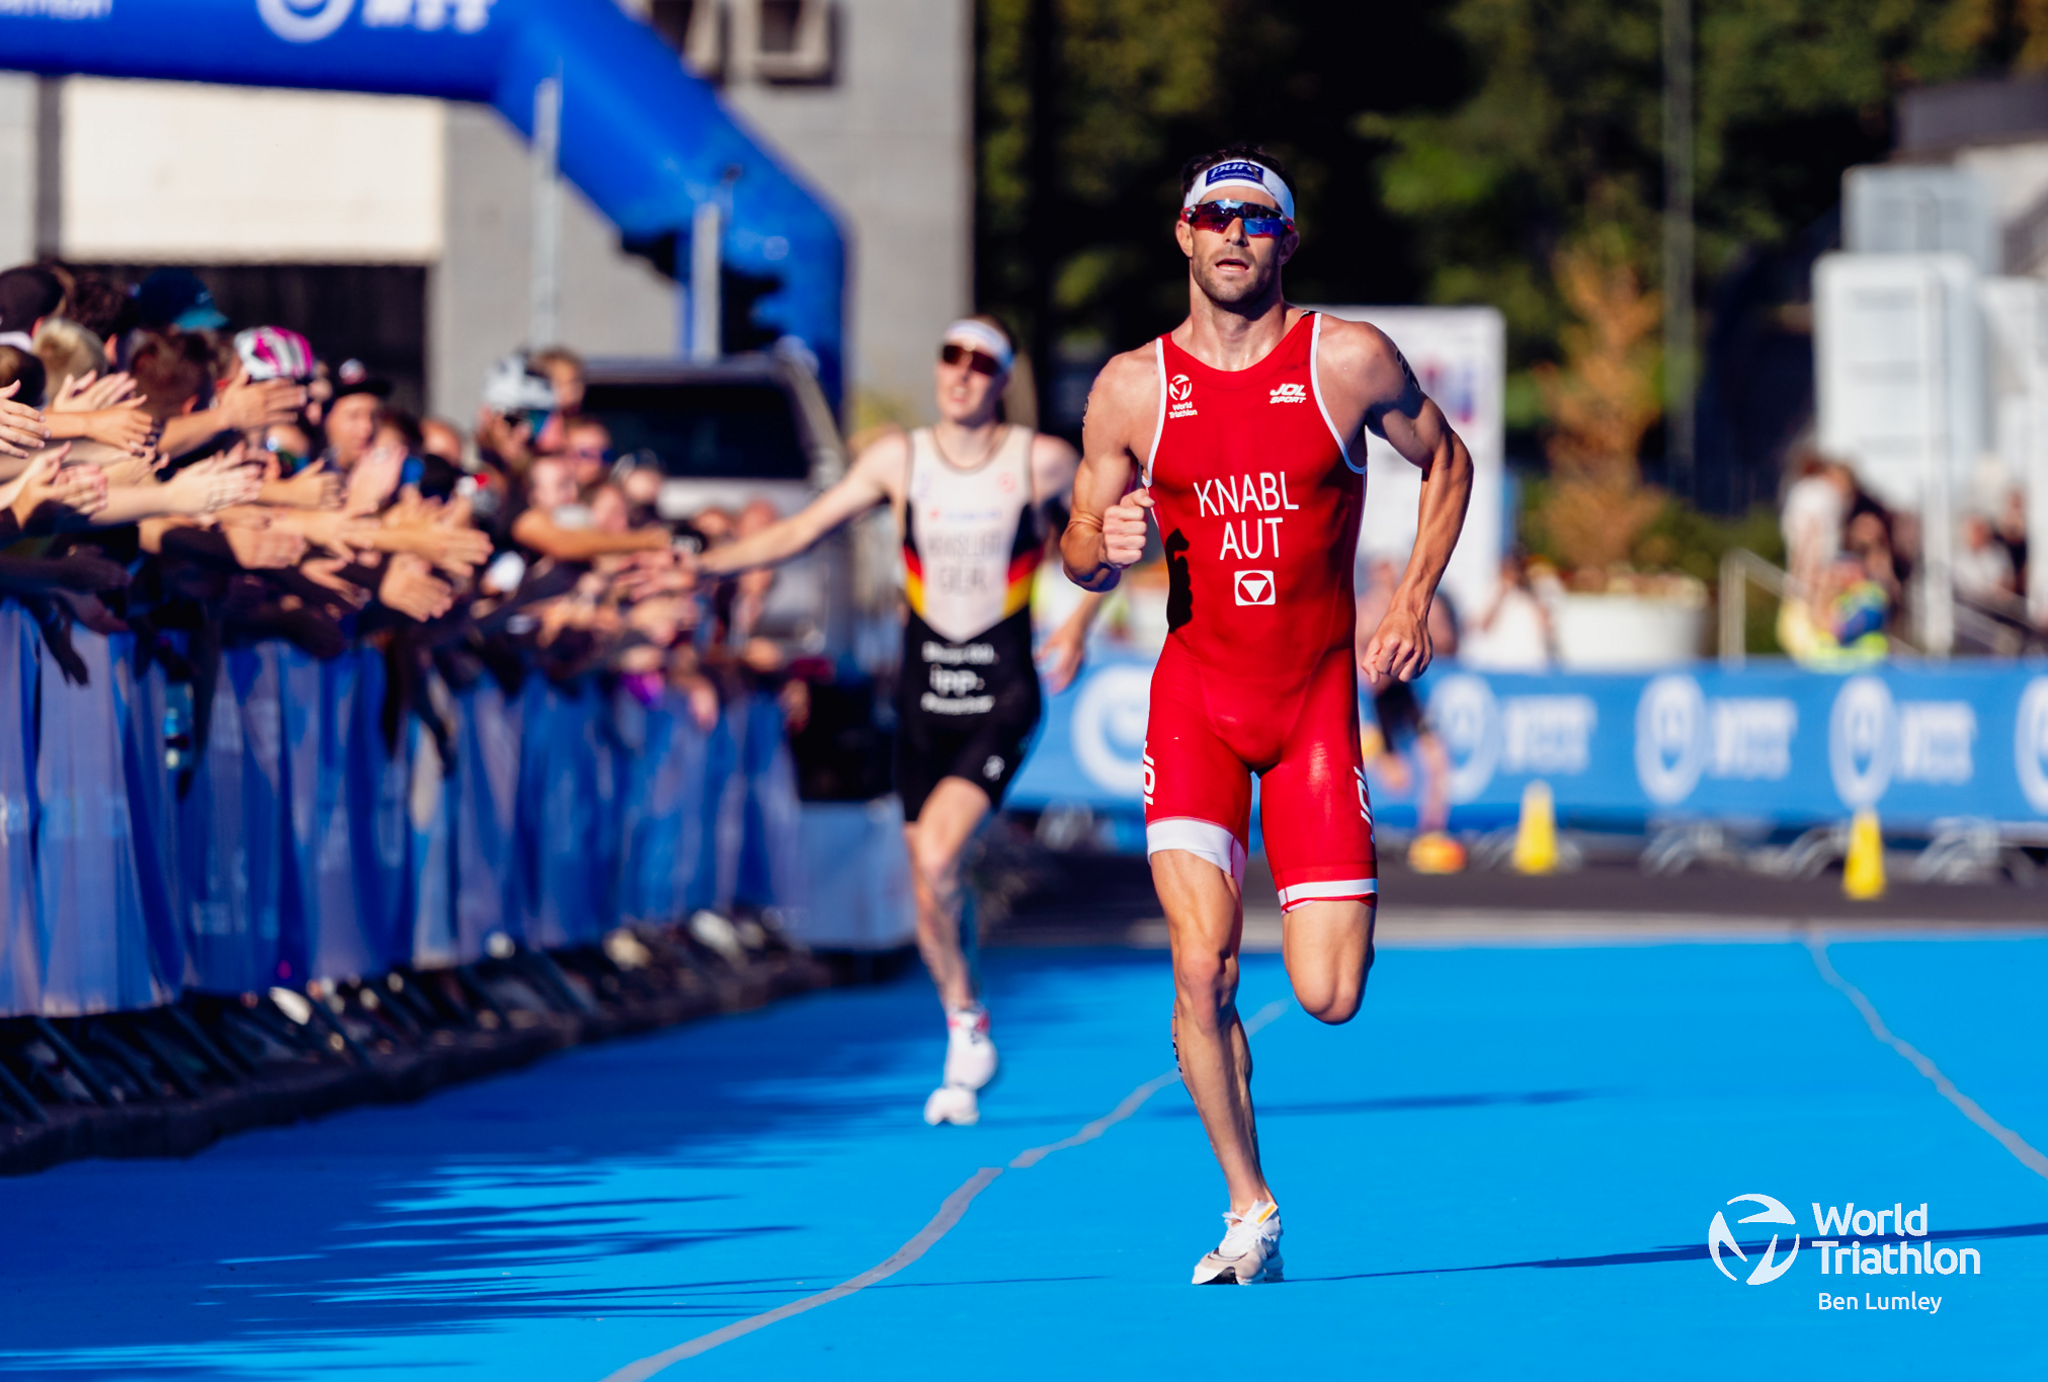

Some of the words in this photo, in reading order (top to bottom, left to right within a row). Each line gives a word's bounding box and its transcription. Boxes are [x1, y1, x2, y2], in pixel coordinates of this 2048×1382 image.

[1211, 163, 1260, 178] pure
[1269, 383, 1306, 396] JOL
[1172, 401, 1193, 411] World
[1269, 396, 1307, 404] SPORT
[1168, 409, 1198, 419] Triathlon
[1193, 471, 1299, 518] KNABL
[1219, 517, 1283, 560] AUT
